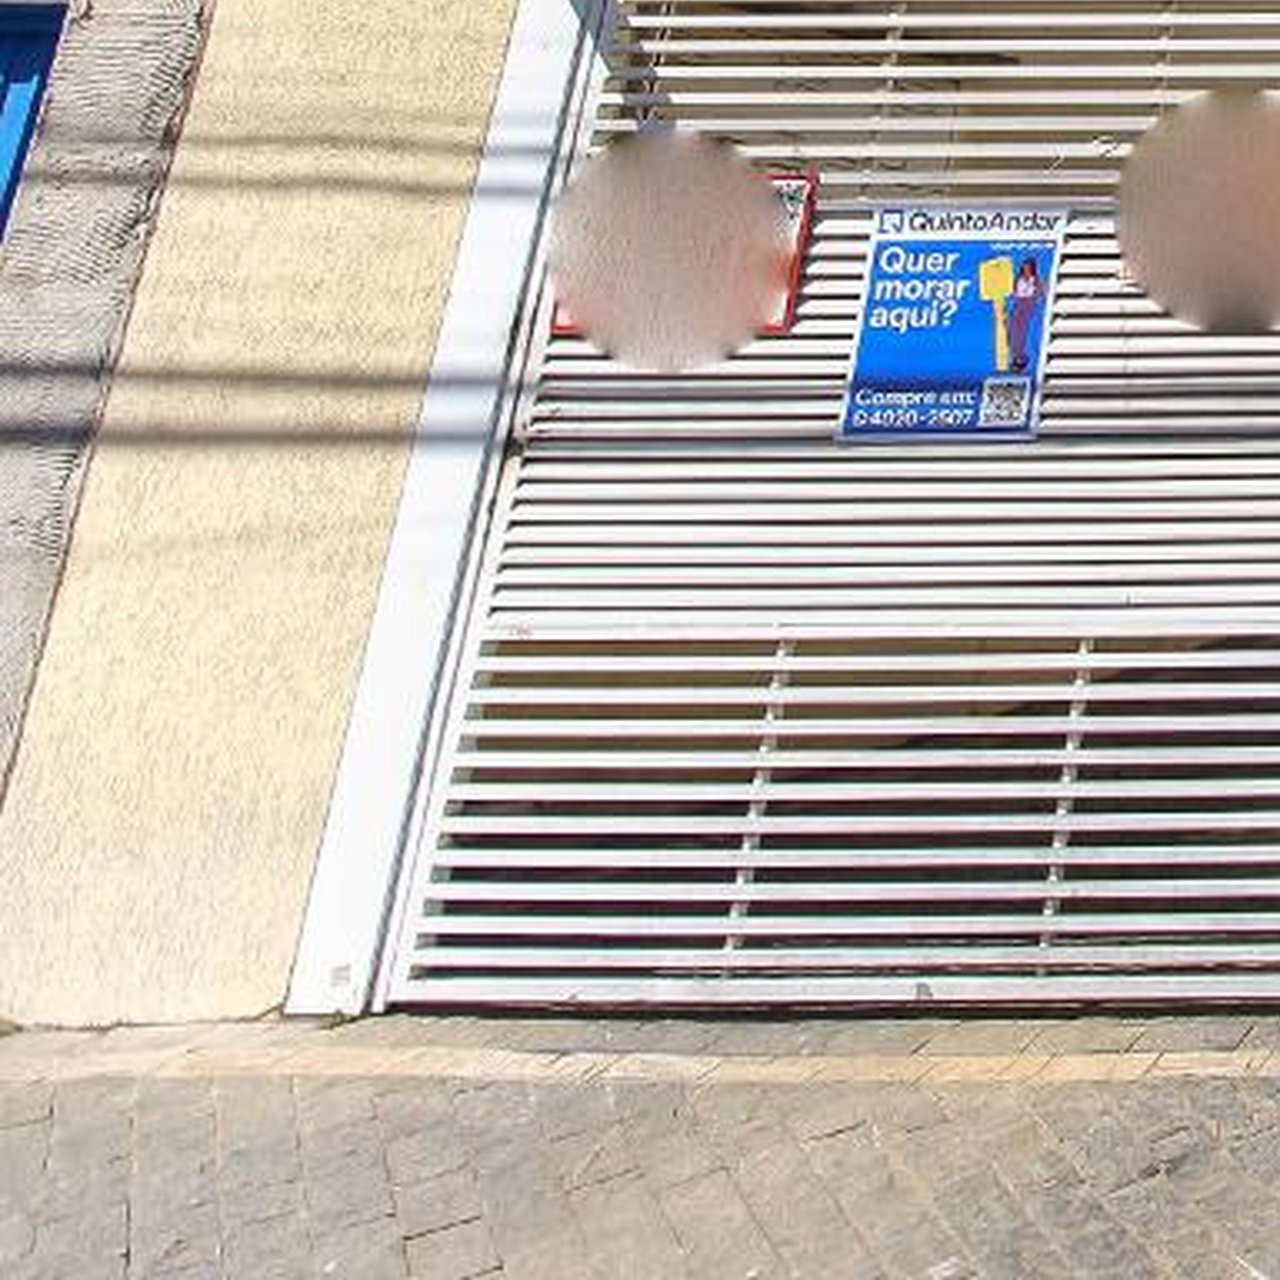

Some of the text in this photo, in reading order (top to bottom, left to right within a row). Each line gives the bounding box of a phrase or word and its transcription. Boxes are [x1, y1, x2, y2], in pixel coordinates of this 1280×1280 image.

[908, 210, 1062, 233] QuintoAndar
[879, 245, 960, 273] Quer
[874, 277, 971, 301] morar
[869, 300, 959, 335] aqui?
[854, 388, 937, 409] Compre
